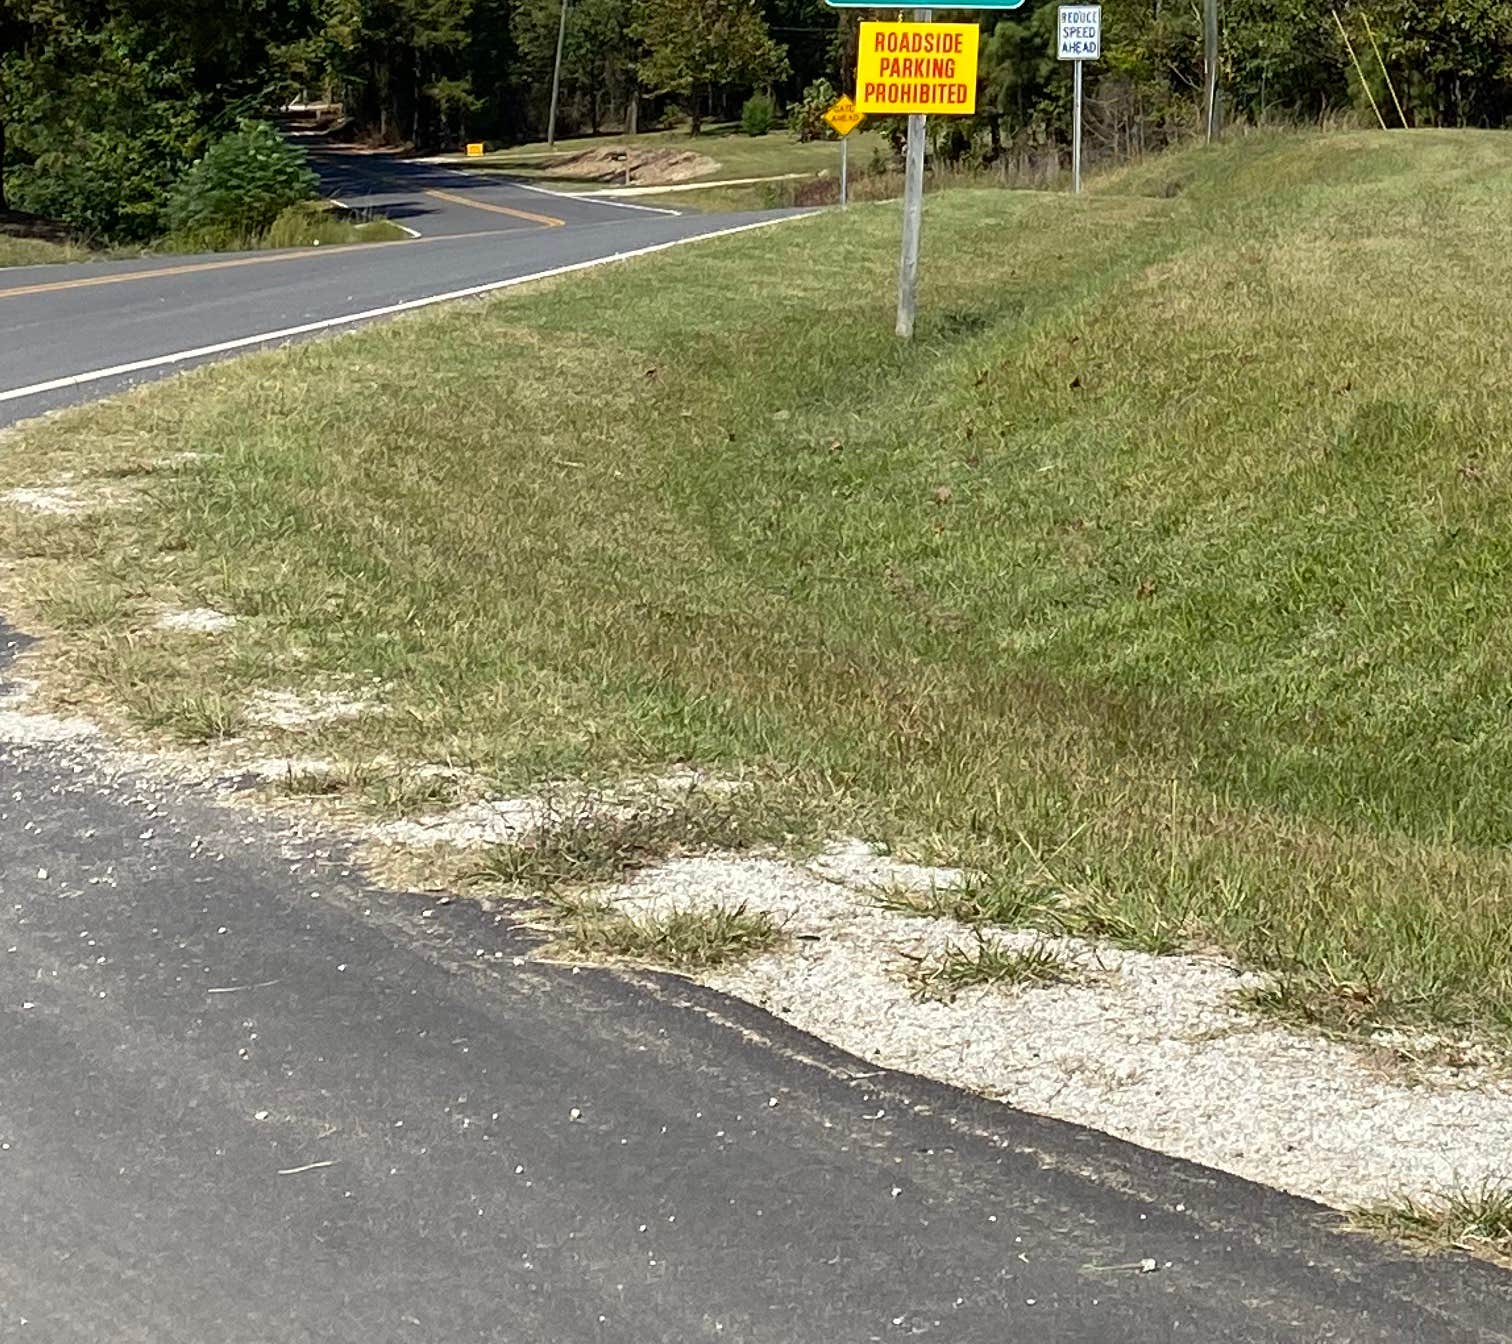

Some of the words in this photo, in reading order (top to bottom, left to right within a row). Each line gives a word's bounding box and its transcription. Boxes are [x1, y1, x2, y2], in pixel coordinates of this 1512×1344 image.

[1061, 11, 1098, 23] REDUCE
[1063, 26, 1096, 38] SPEED
[875, 32, 963, 53] ROADSIDE
[1062, 41, 1097, 54] AHEAD
[879, 58, 955, 78] PARKING
[864, 83, 967, 104] PROHIBITED
